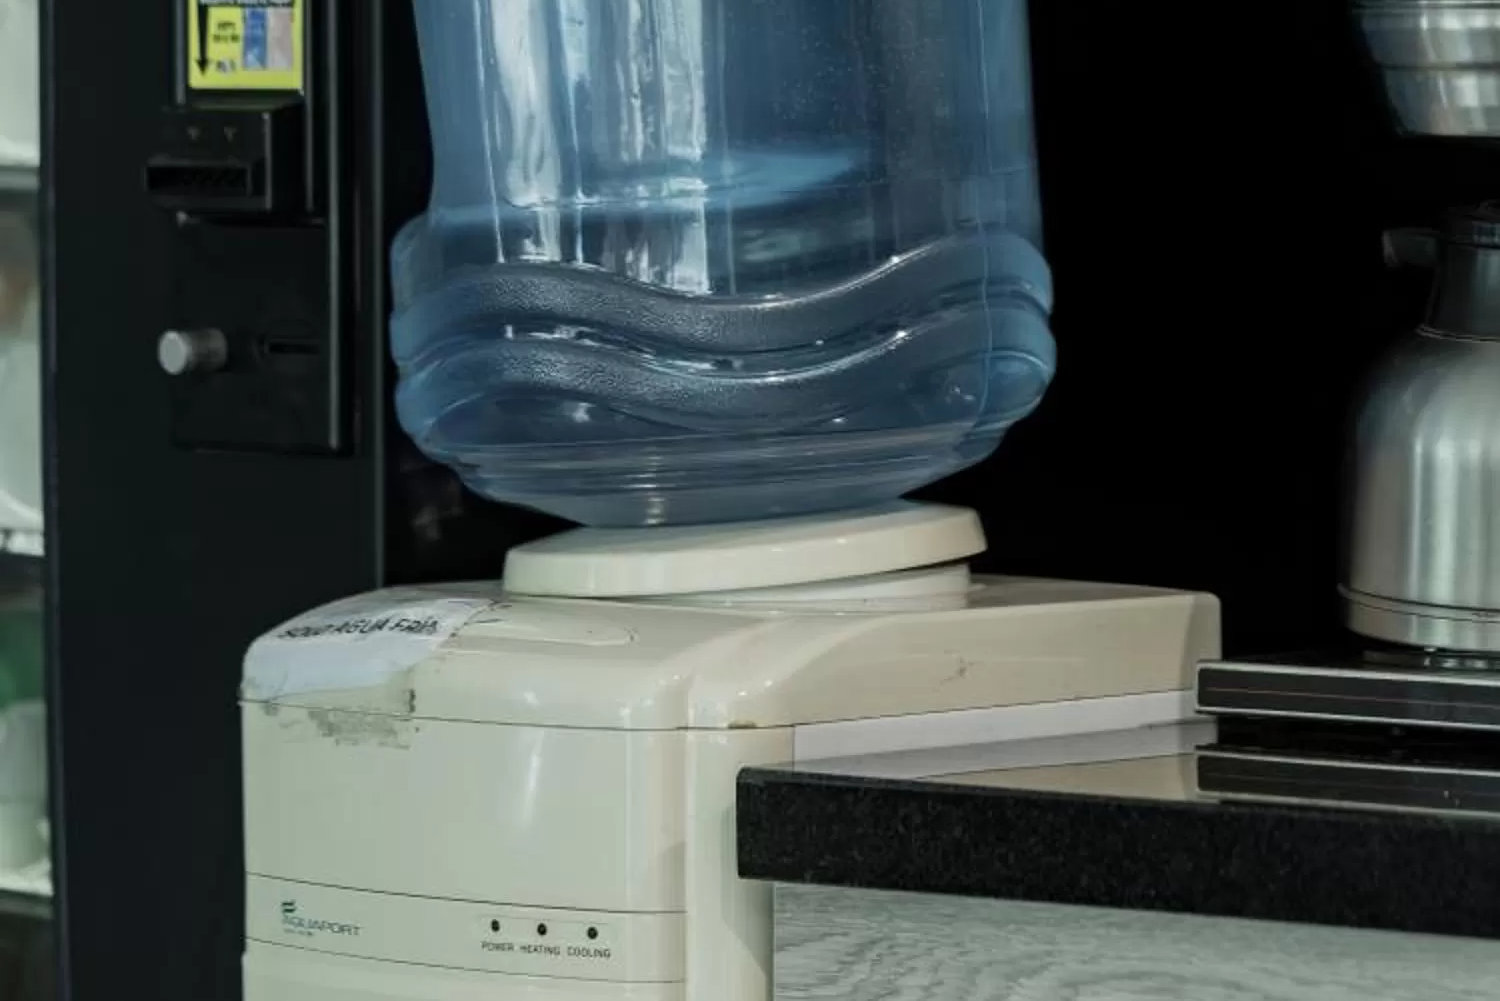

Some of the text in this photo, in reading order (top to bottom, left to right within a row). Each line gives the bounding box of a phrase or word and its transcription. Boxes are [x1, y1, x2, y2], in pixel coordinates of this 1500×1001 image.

[481, 942, 611, 958] POWER HEATING COOLING
